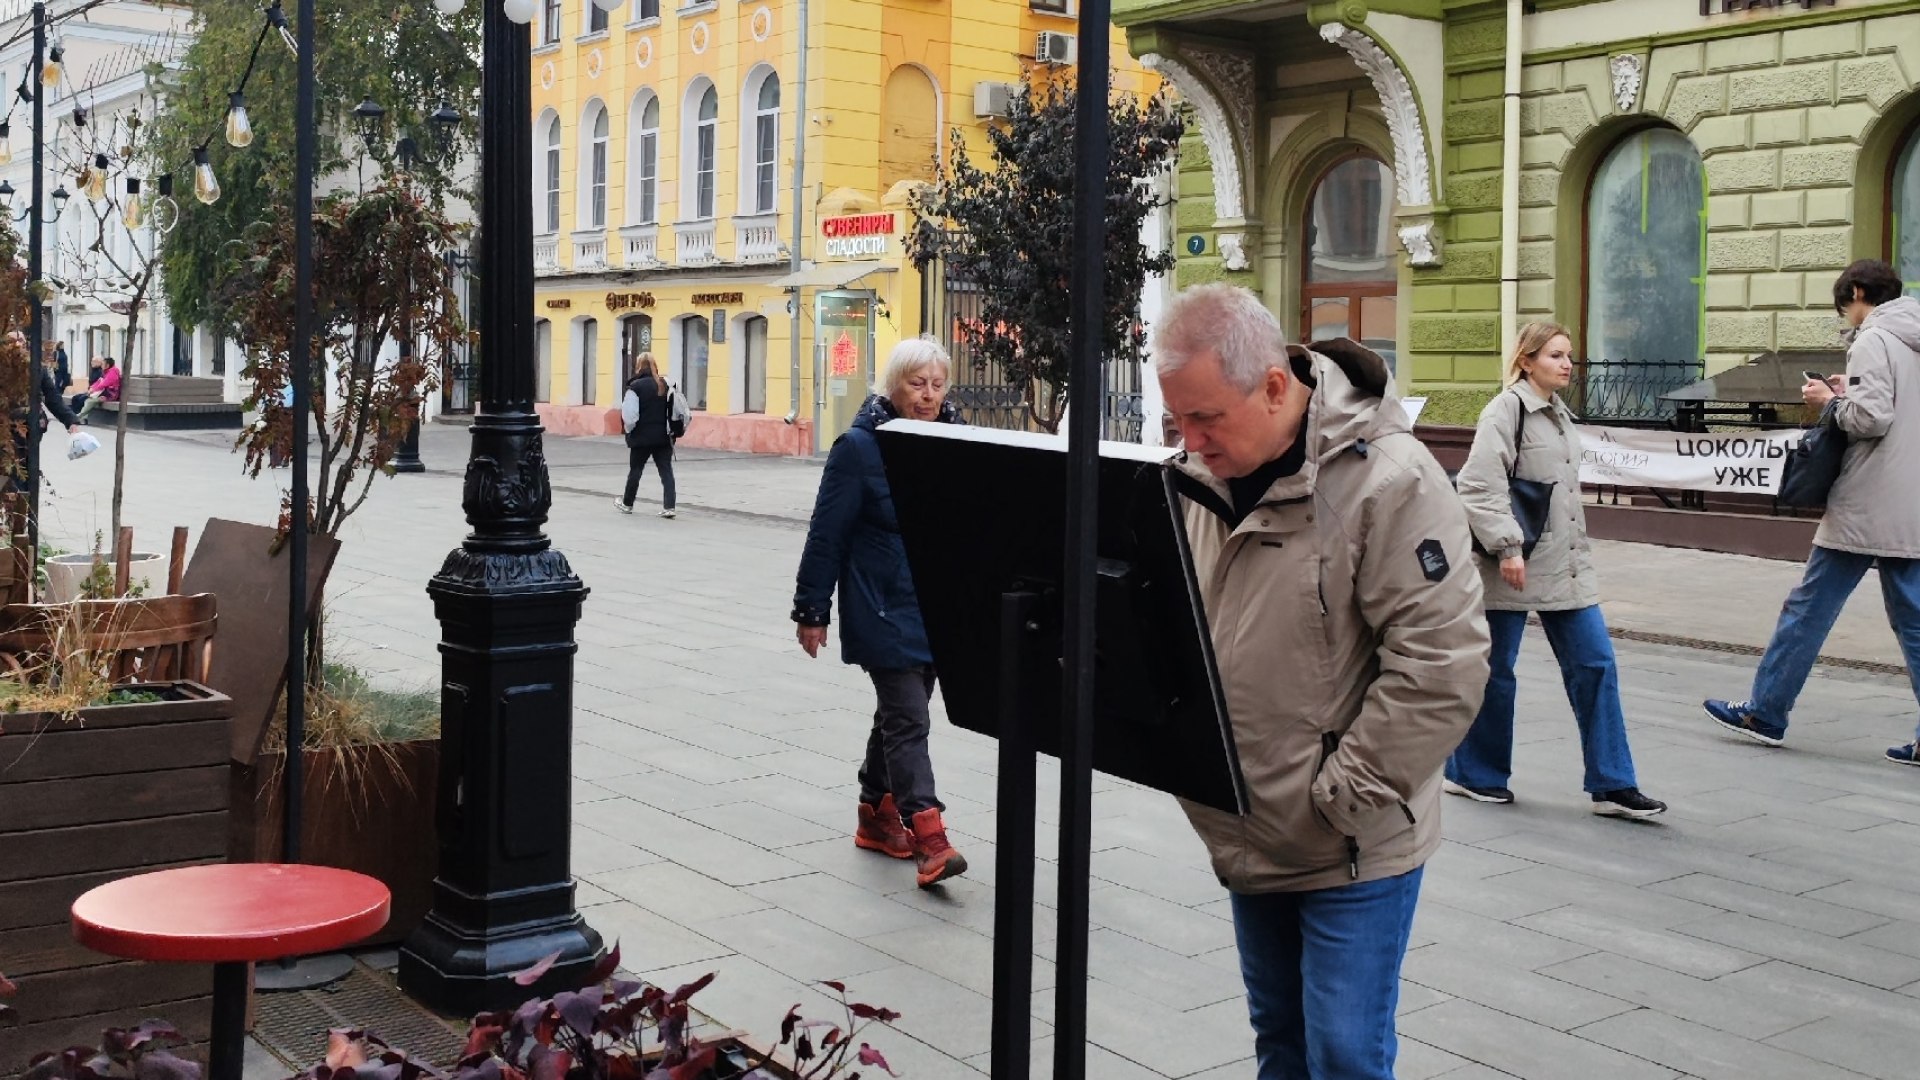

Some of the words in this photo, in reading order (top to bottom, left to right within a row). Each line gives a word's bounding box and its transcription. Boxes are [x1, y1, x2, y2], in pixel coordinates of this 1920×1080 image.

[822, 213, 895, 238] СУВЕНИРЫ
[826, 235, 887, 258] СЛАДОСТИ
[1192, 239, 1199, 251] 7
[1714, 466, 1770, 487] УЖЕ
